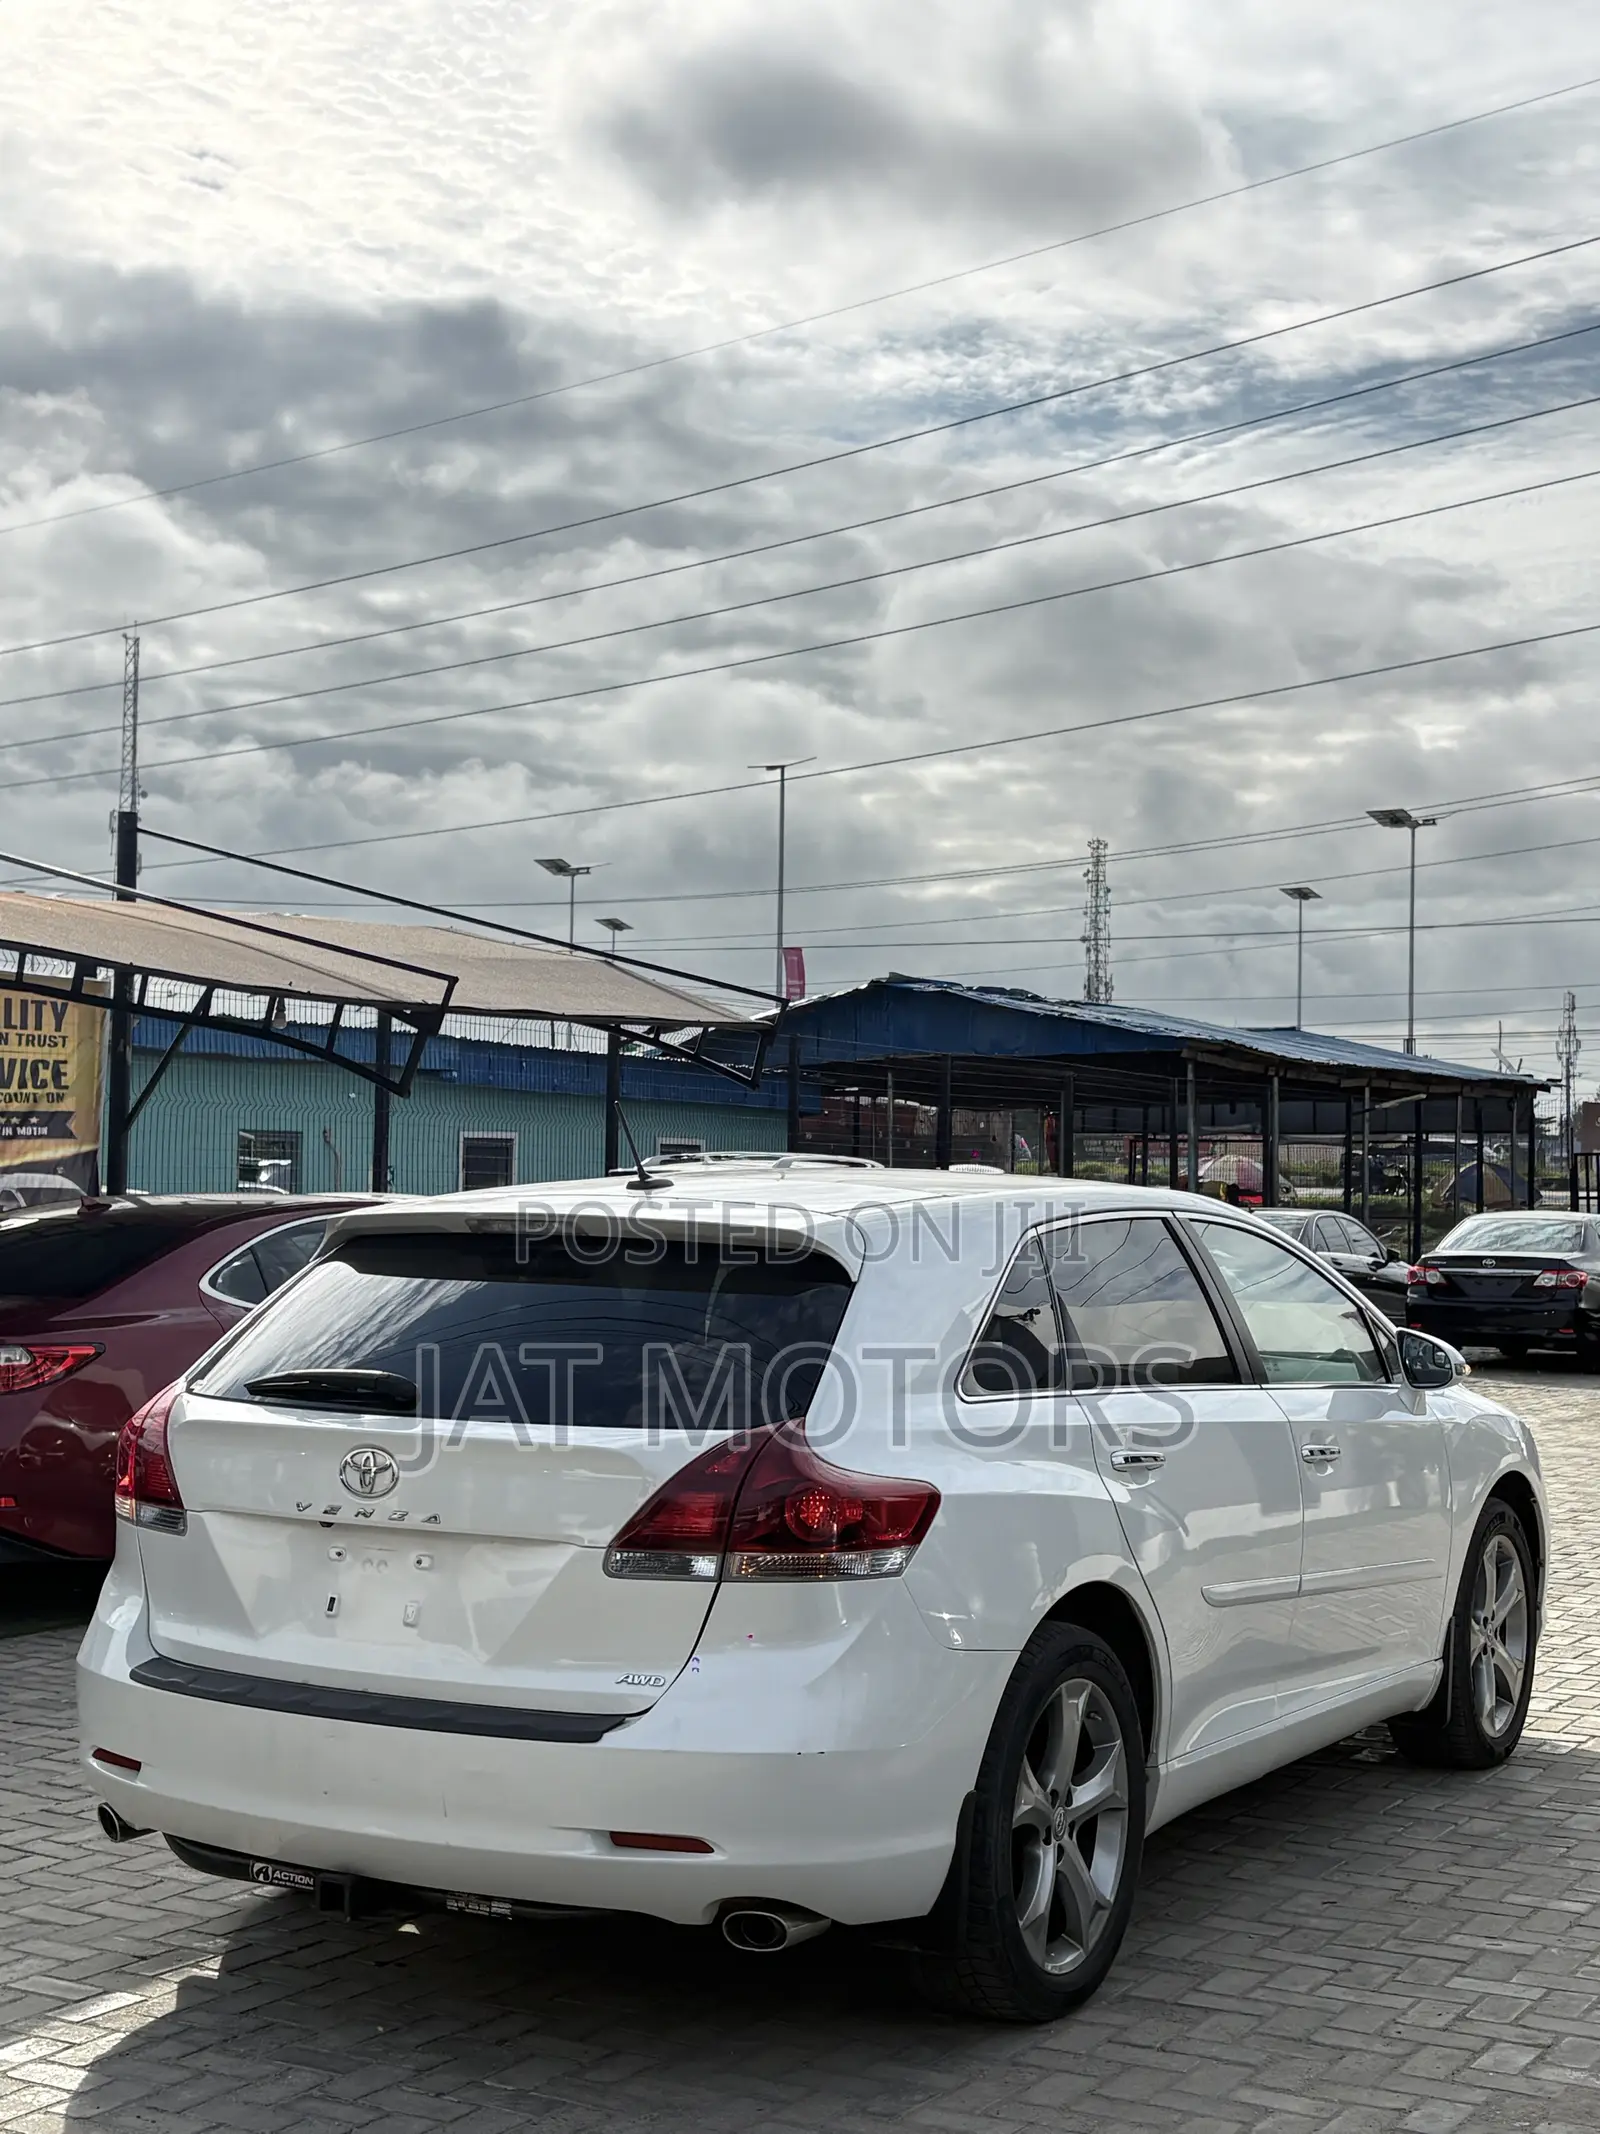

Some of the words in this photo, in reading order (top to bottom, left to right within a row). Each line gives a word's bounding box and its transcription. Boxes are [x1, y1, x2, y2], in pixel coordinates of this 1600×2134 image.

[3, 997, 69, 1032] LITY
[15, 1032, 69, 1048] TRUST
[0, 1057, 70, 1090] VICE
[46, 1091, 65, 1104] ON
[296, 1501, 442, 1525] VENZA
[614, 1672, 666, 1687] AWD
[272, 1869, 314, 1886] ACTION
